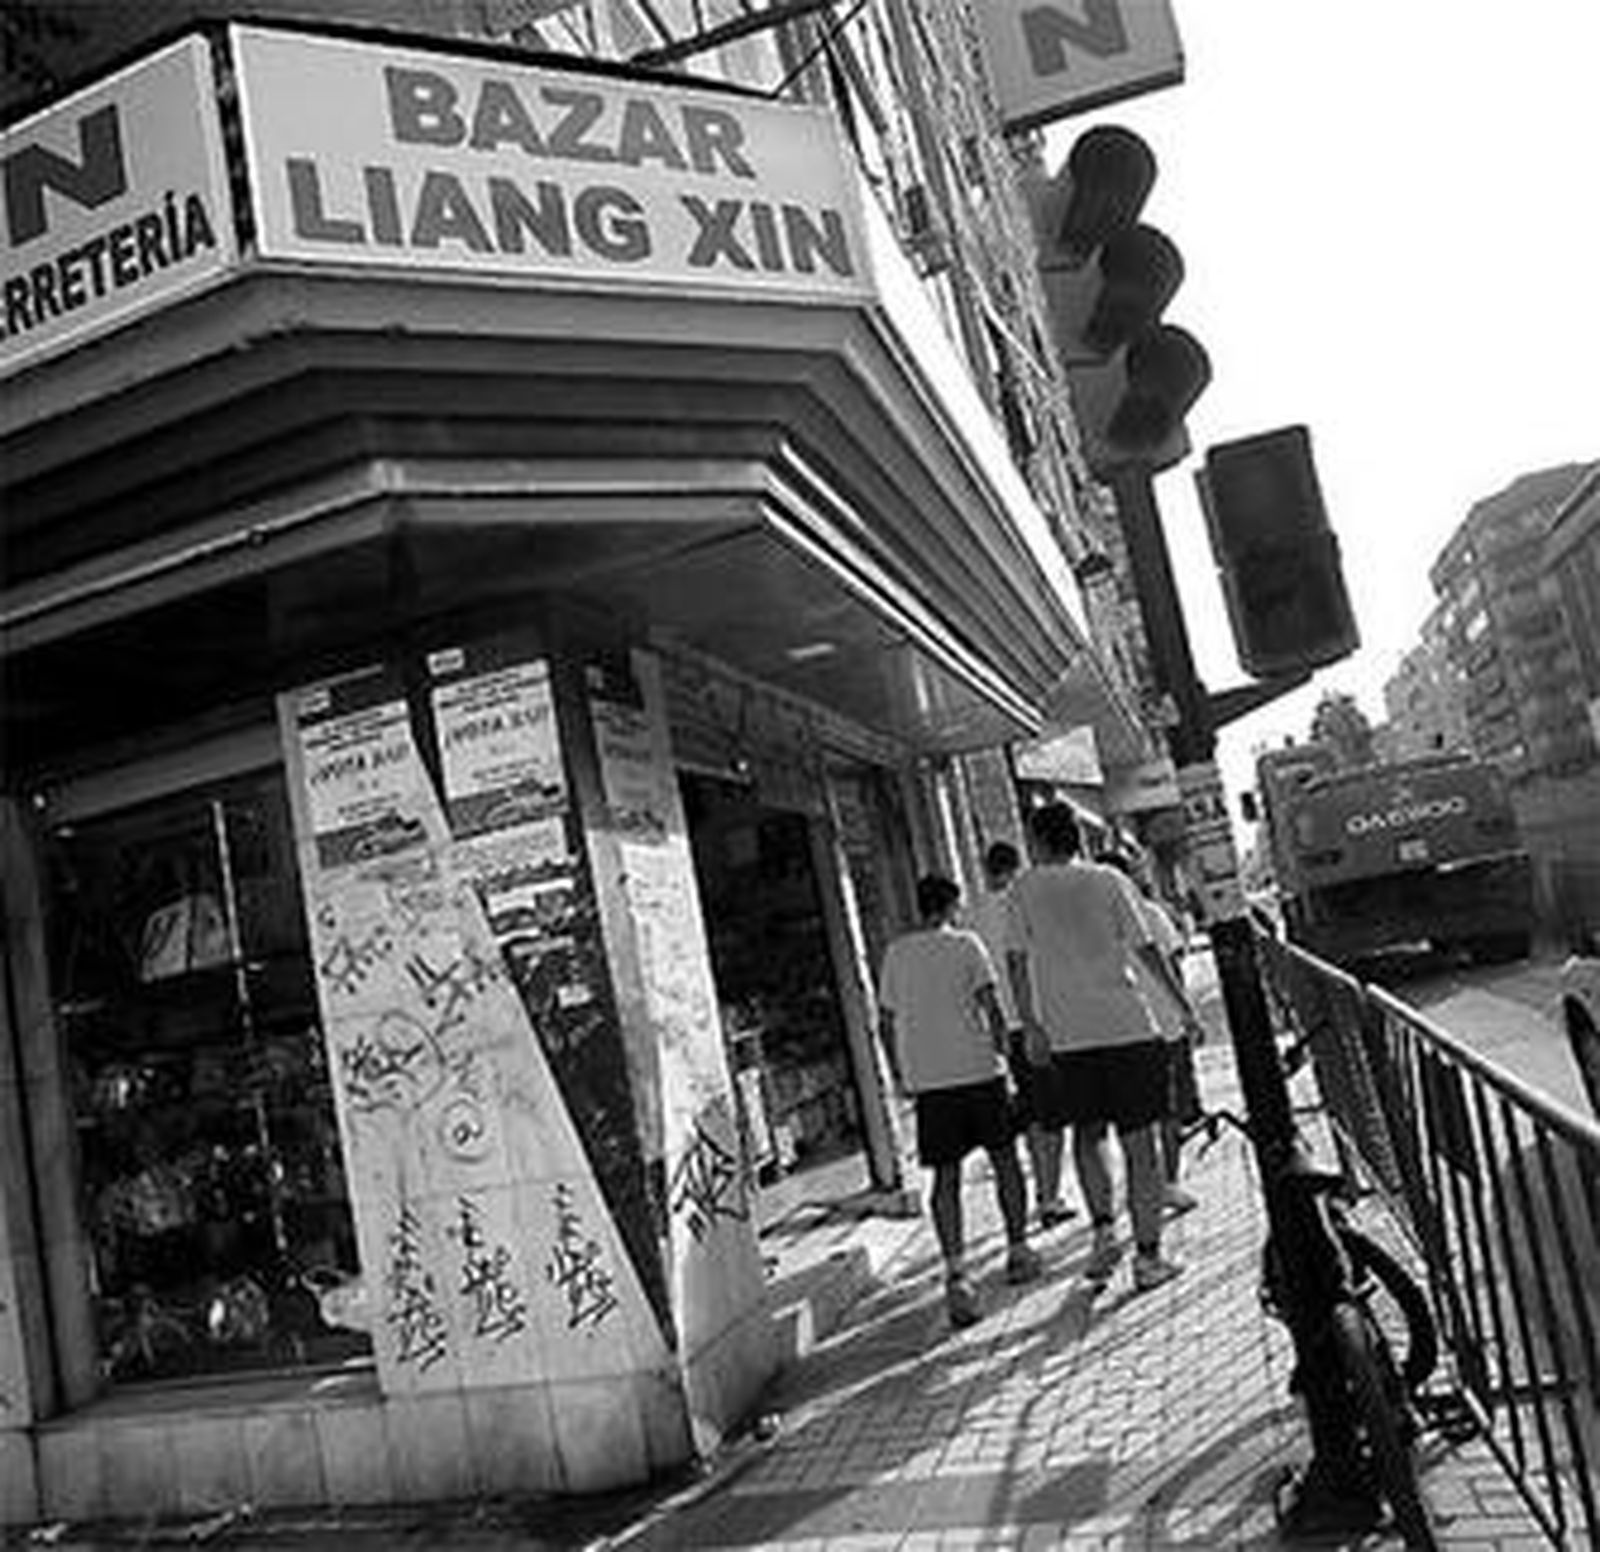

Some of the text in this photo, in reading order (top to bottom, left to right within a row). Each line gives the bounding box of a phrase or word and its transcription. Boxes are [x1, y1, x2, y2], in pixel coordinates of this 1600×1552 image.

[1020, 0, 1129, 77] N
[1, 104, 128, 248] N
[385, 66, 755, 179] BAZAR
[0, 189, 215, 341] RRETERÍA
[287, 159, 853, 276] LIANG XIN
